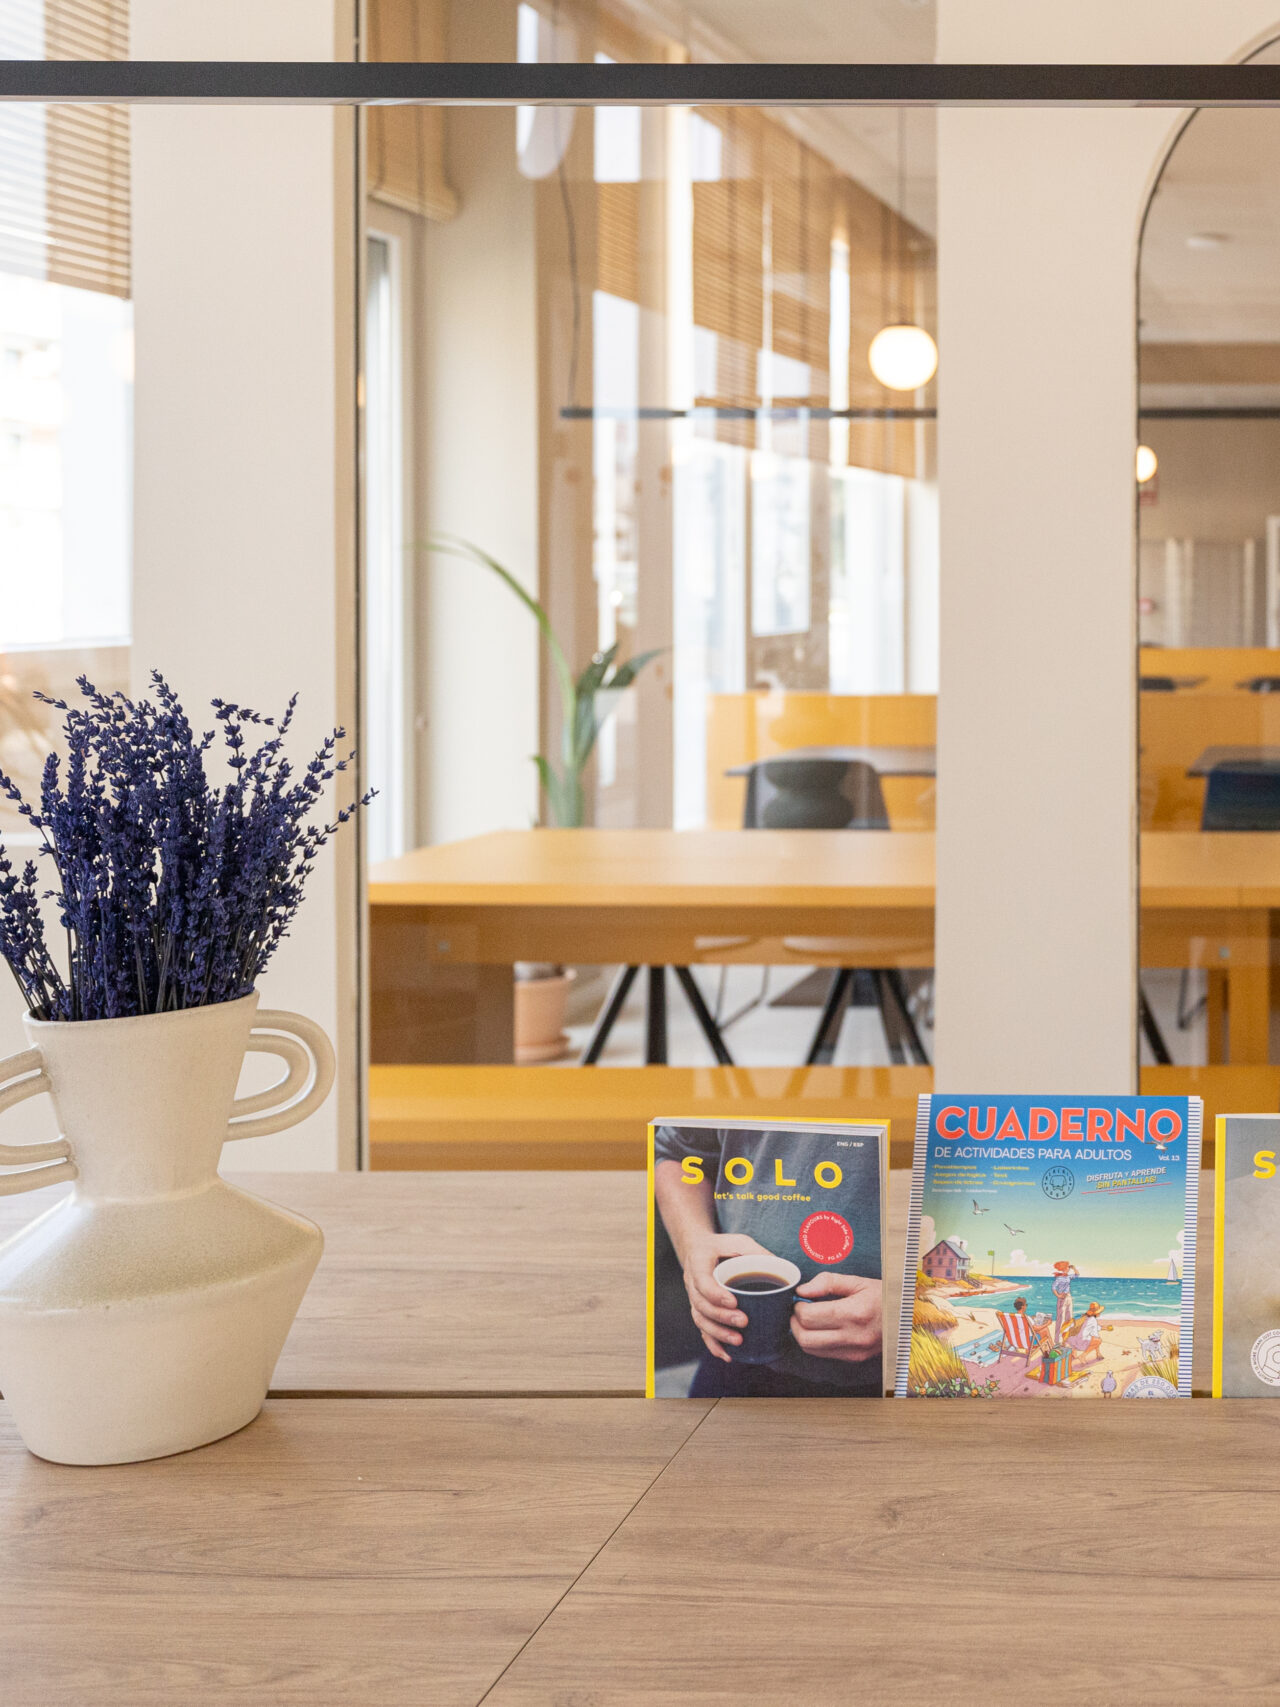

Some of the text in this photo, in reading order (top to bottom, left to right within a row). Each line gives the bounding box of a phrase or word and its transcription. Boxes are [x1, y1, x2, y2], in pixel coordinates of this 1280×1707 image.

[935, 1105, 1183, 1143] CUADERNO
[934, 1146, 1132, 1161] DE ACTIVIDADES PARA ADULTOS
[681, 1156, 843, 1189] SOLO
[1086, 1171, 1123, 1182] DISFRUTA
[1131, 1167, 1167, 1177] APRENDE
[714, 1191, 811, 1202] let's talk good coffee
